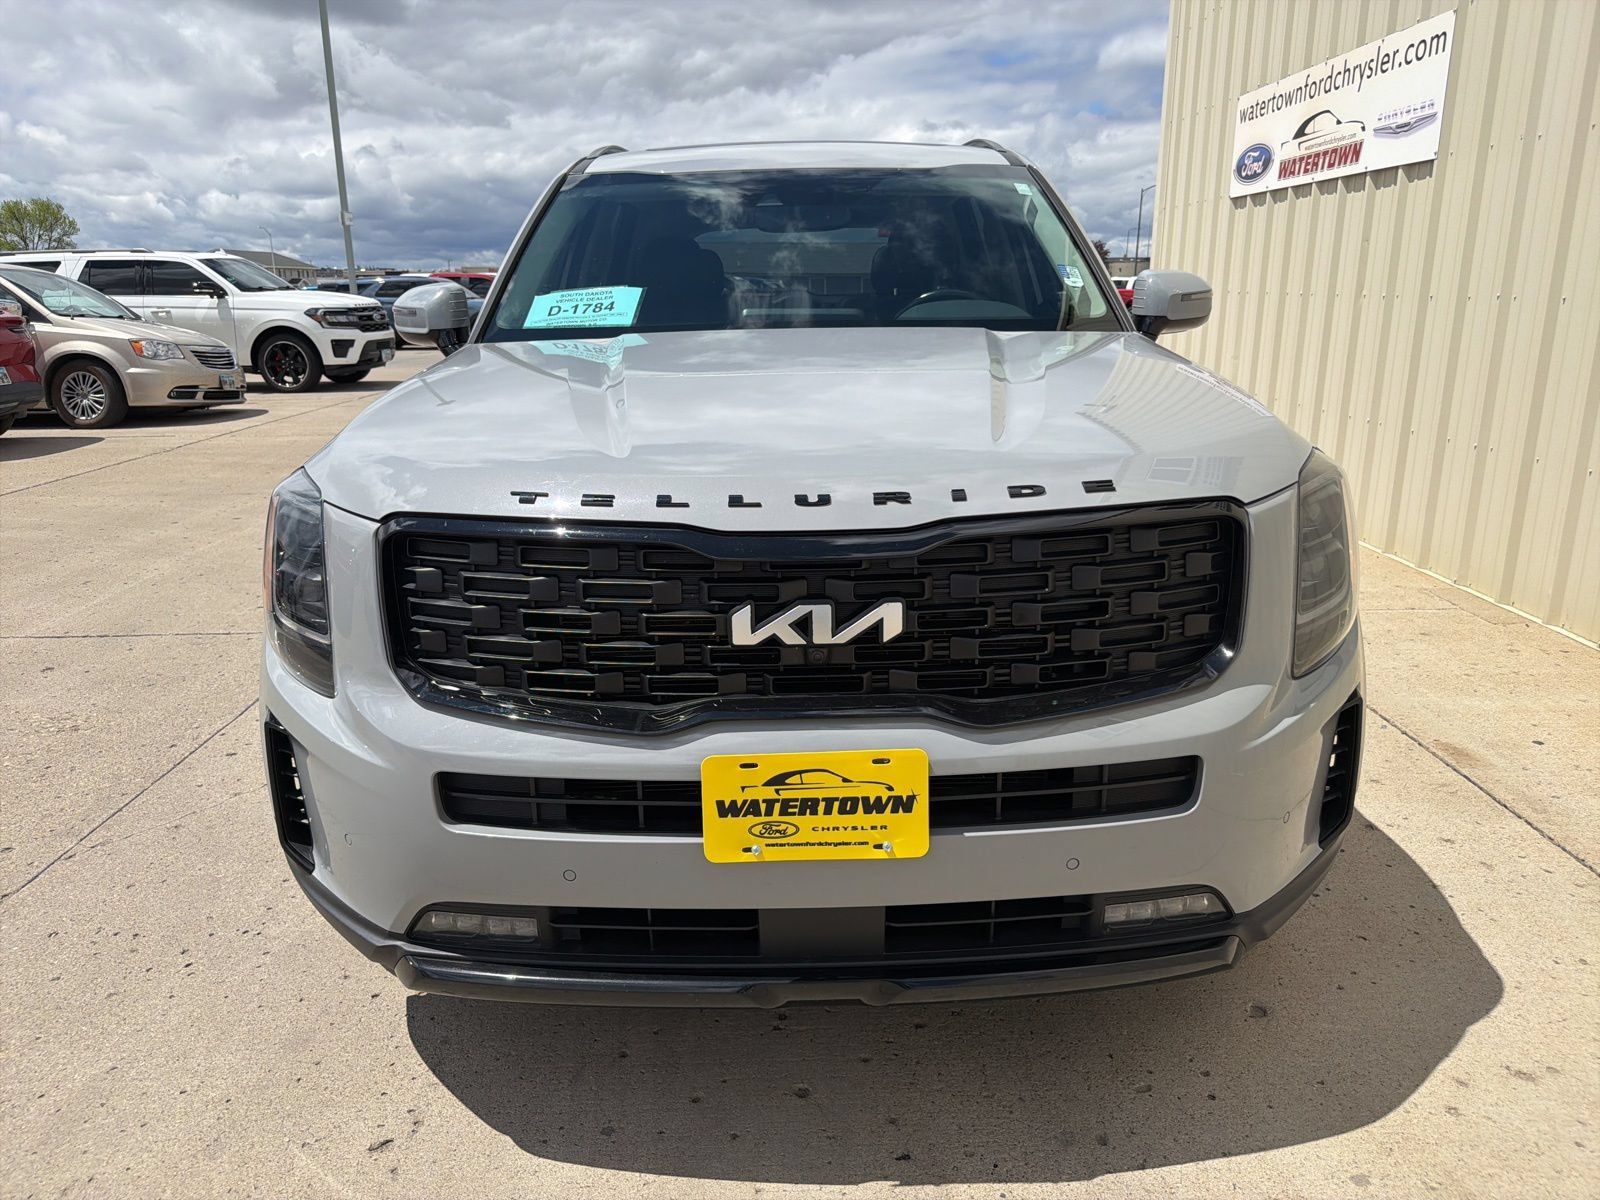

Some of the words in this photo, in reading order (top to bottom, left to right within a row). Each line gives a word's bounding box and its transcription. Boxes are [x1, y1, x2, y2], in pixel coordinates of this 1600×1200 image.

[1239, 30, 1447, 124] watertownfordchrysler.com
[1241, 151, 1264, 176] Ford
[1277, 139, 1364, 180] WATERTOWN
[547, 301, 615, 317] D-1784
[510, 479, 1116, 508] TELLURIDE
[731, 601, 904, 646] KIA
[715, 794, 915, 819] WATERTOWN
[759, 823, 788, 837] Ford
[811, 824, 889, 832] CHRYSLER
[765, 840, 869, 849] watertownfordchrysler.com
